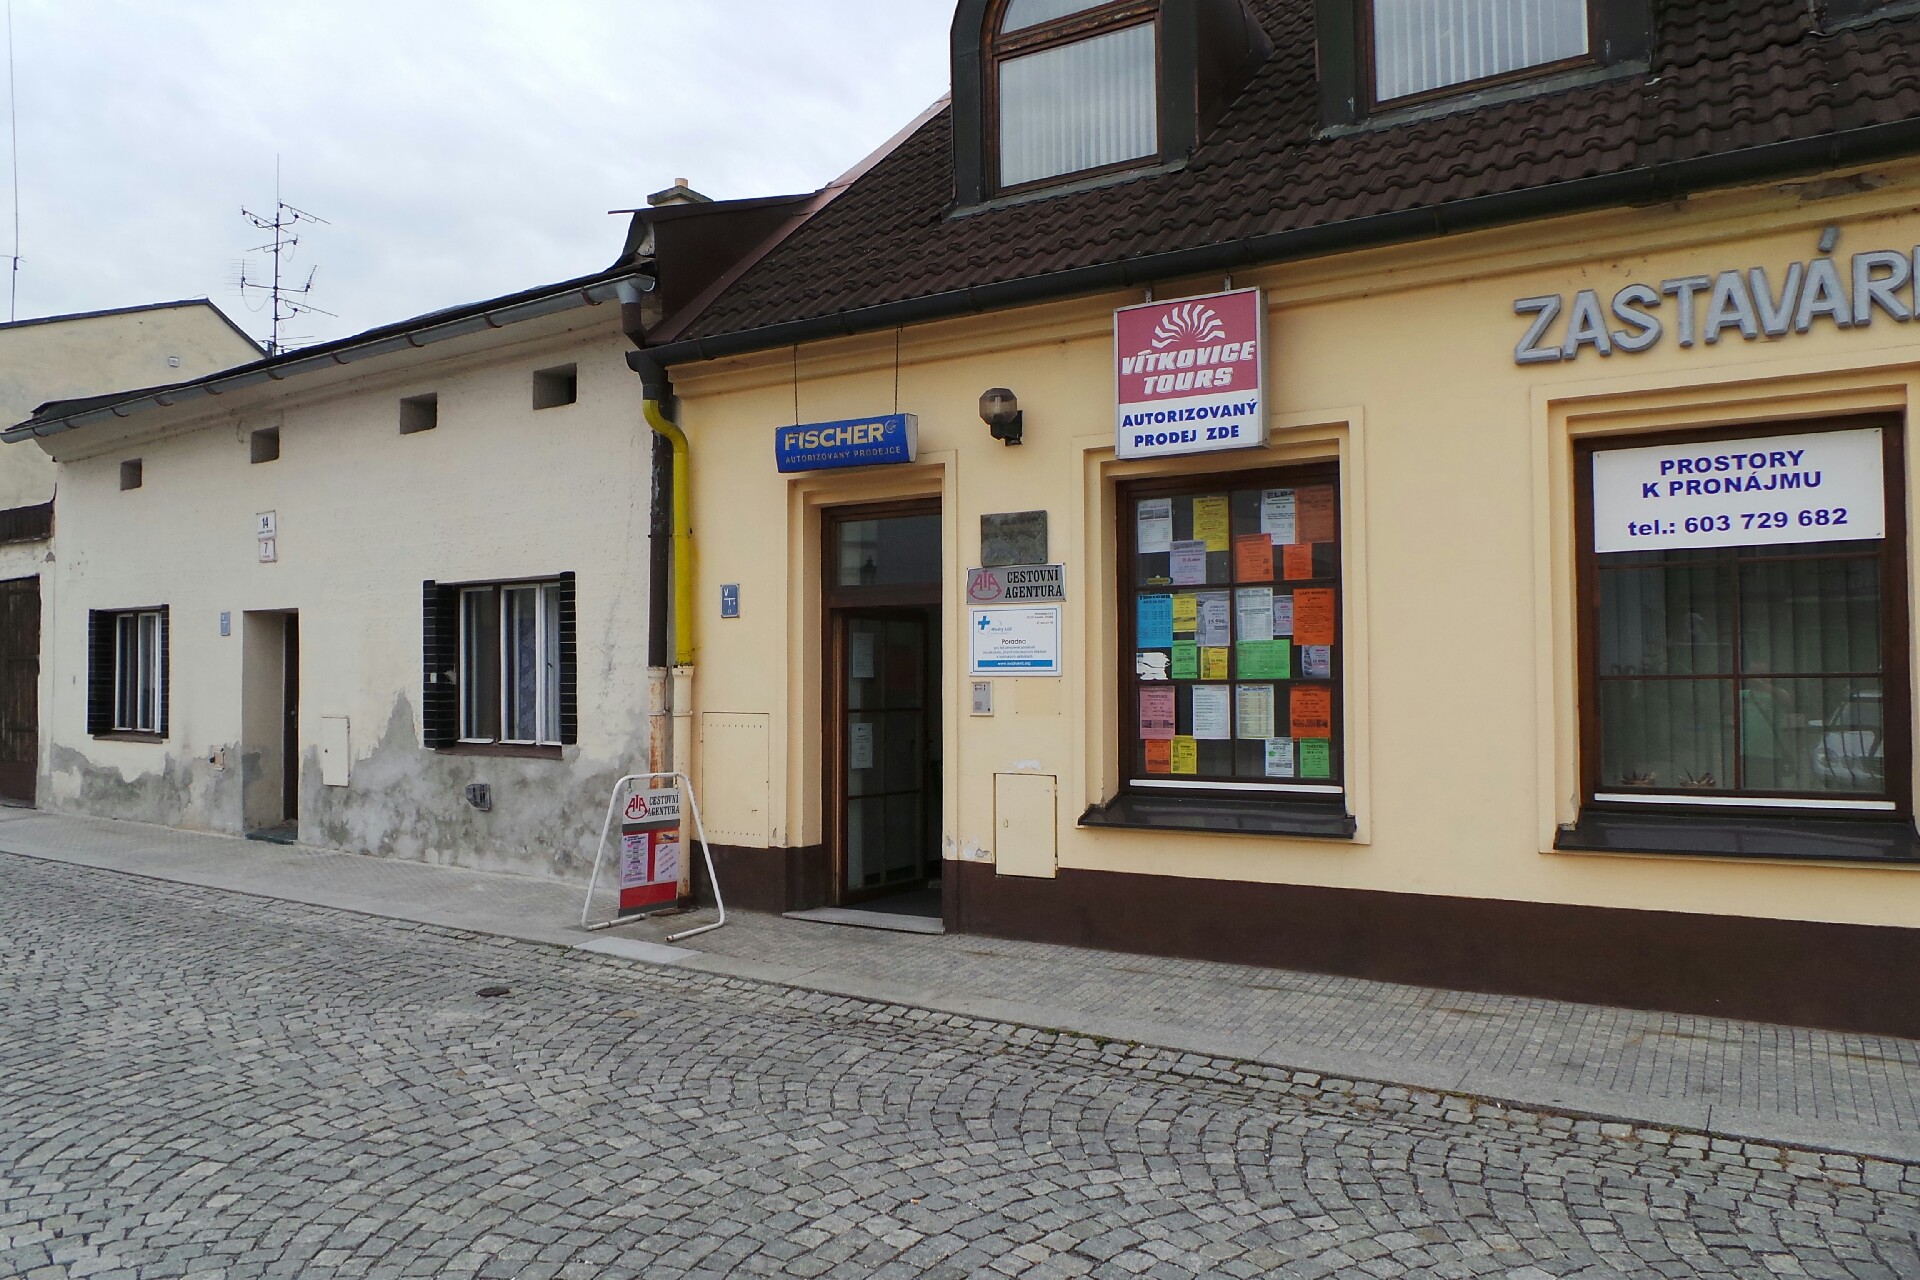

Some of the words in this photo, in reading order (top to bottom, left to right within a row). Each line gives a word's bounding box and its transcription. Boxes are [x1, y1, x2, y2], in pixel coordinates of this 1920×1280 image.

[1514, 226, 1920, 365] ZASTAVÁR
[1121, 340, 1256, 375] VÍTKOVICE
[1143, 367, 1233, 396] TOURS
[1122, 398, 1258, 428] AUTORIZOVANÝ
[784, 423, 885, 451] FISCHER
[1134, 429, 1197, 448] PRODEJ
[1206, 424, 1240, 441] ZDE
[853, 445, 901, 458] PRODEJCE
[1659, 449, 1806, 476] PROSTORY
[1641, 481, 1660, 499] K
[1669, 470, 1822, 497] PRONÁJMU
[1627, 518, 1676, 537] tel.:
[1684, 514, 1732, 534] 603
[1741, 510, 1789, 530] 729
[1797, 507, 1848, 527] 682
[1006, 565, 1060, 584] CESTOVNÍ
[1004, 583, 1063, 599] AGENTURA
[649, 792, 680, 806] CESTOVNÍ
